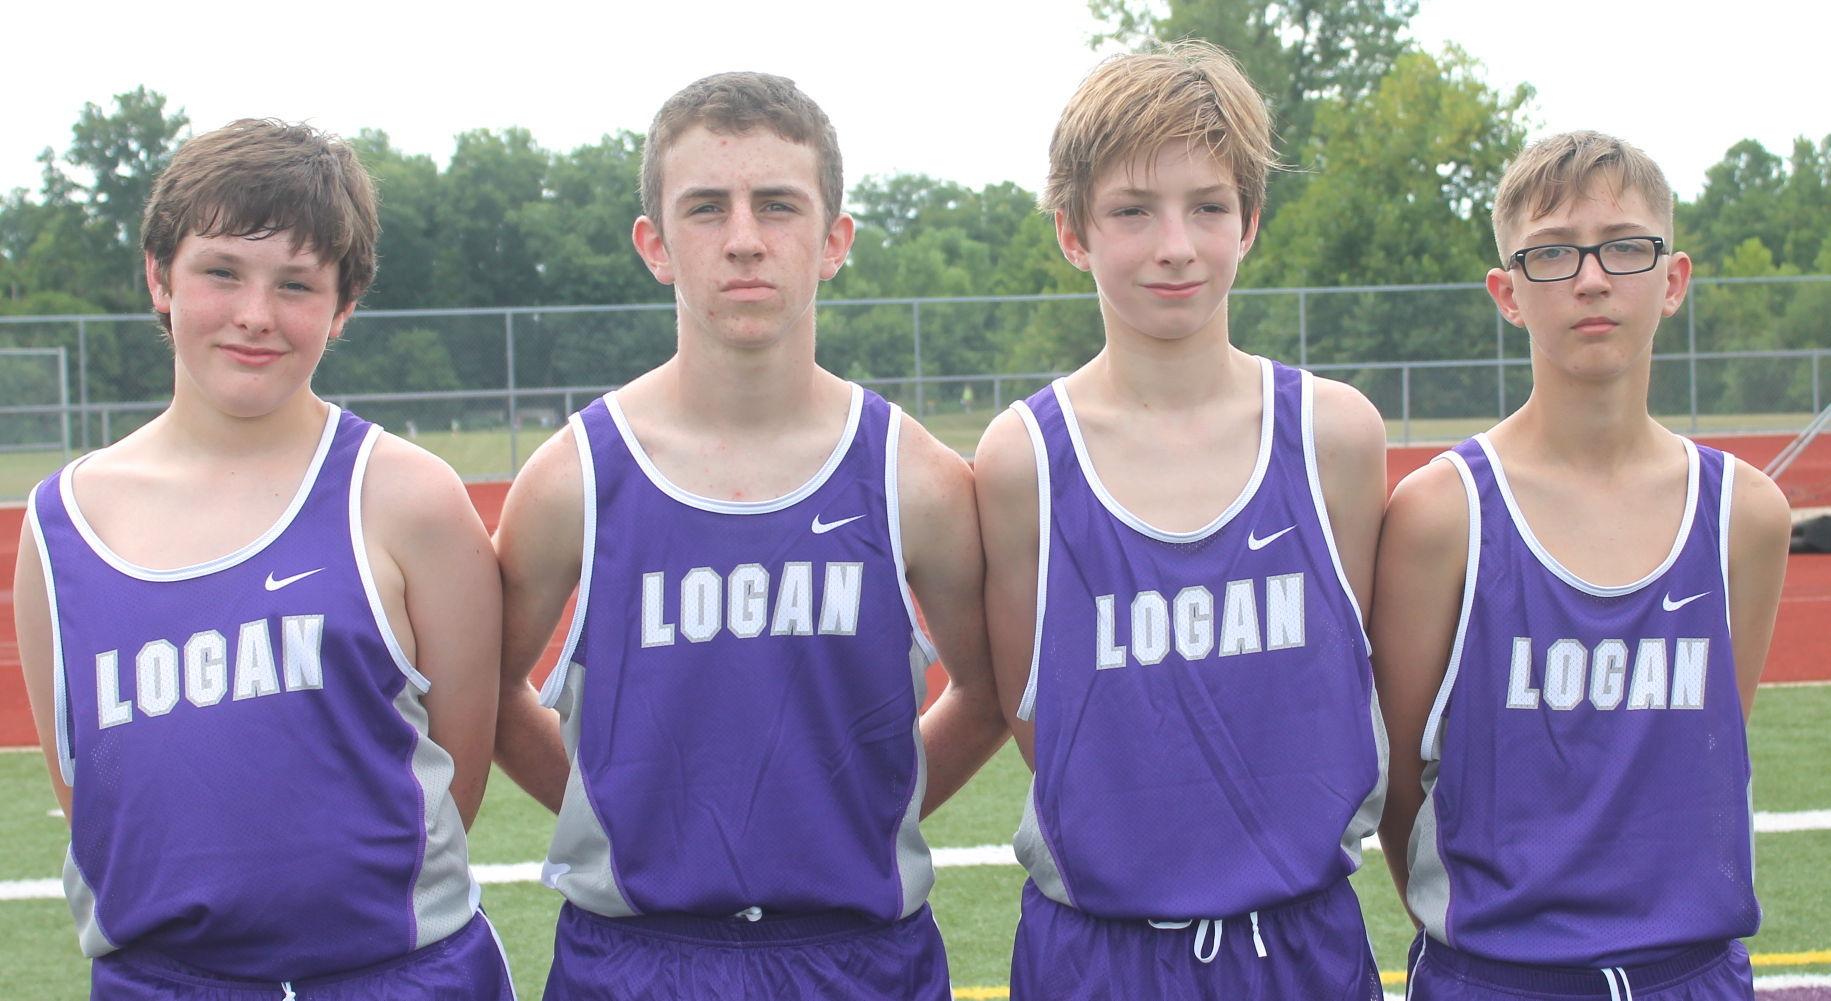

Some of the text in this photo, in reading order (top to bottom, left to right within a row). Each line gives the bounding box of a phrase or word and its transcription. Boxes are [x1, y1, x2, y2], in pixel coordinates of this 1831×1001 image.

[640, 561, 864, 649] LOGAN
[1095, 572, 1307, 671] LOGAN
[95, 613, 325, 730] LOGAN
[1505, 637, 1710, 711] LOGAN
